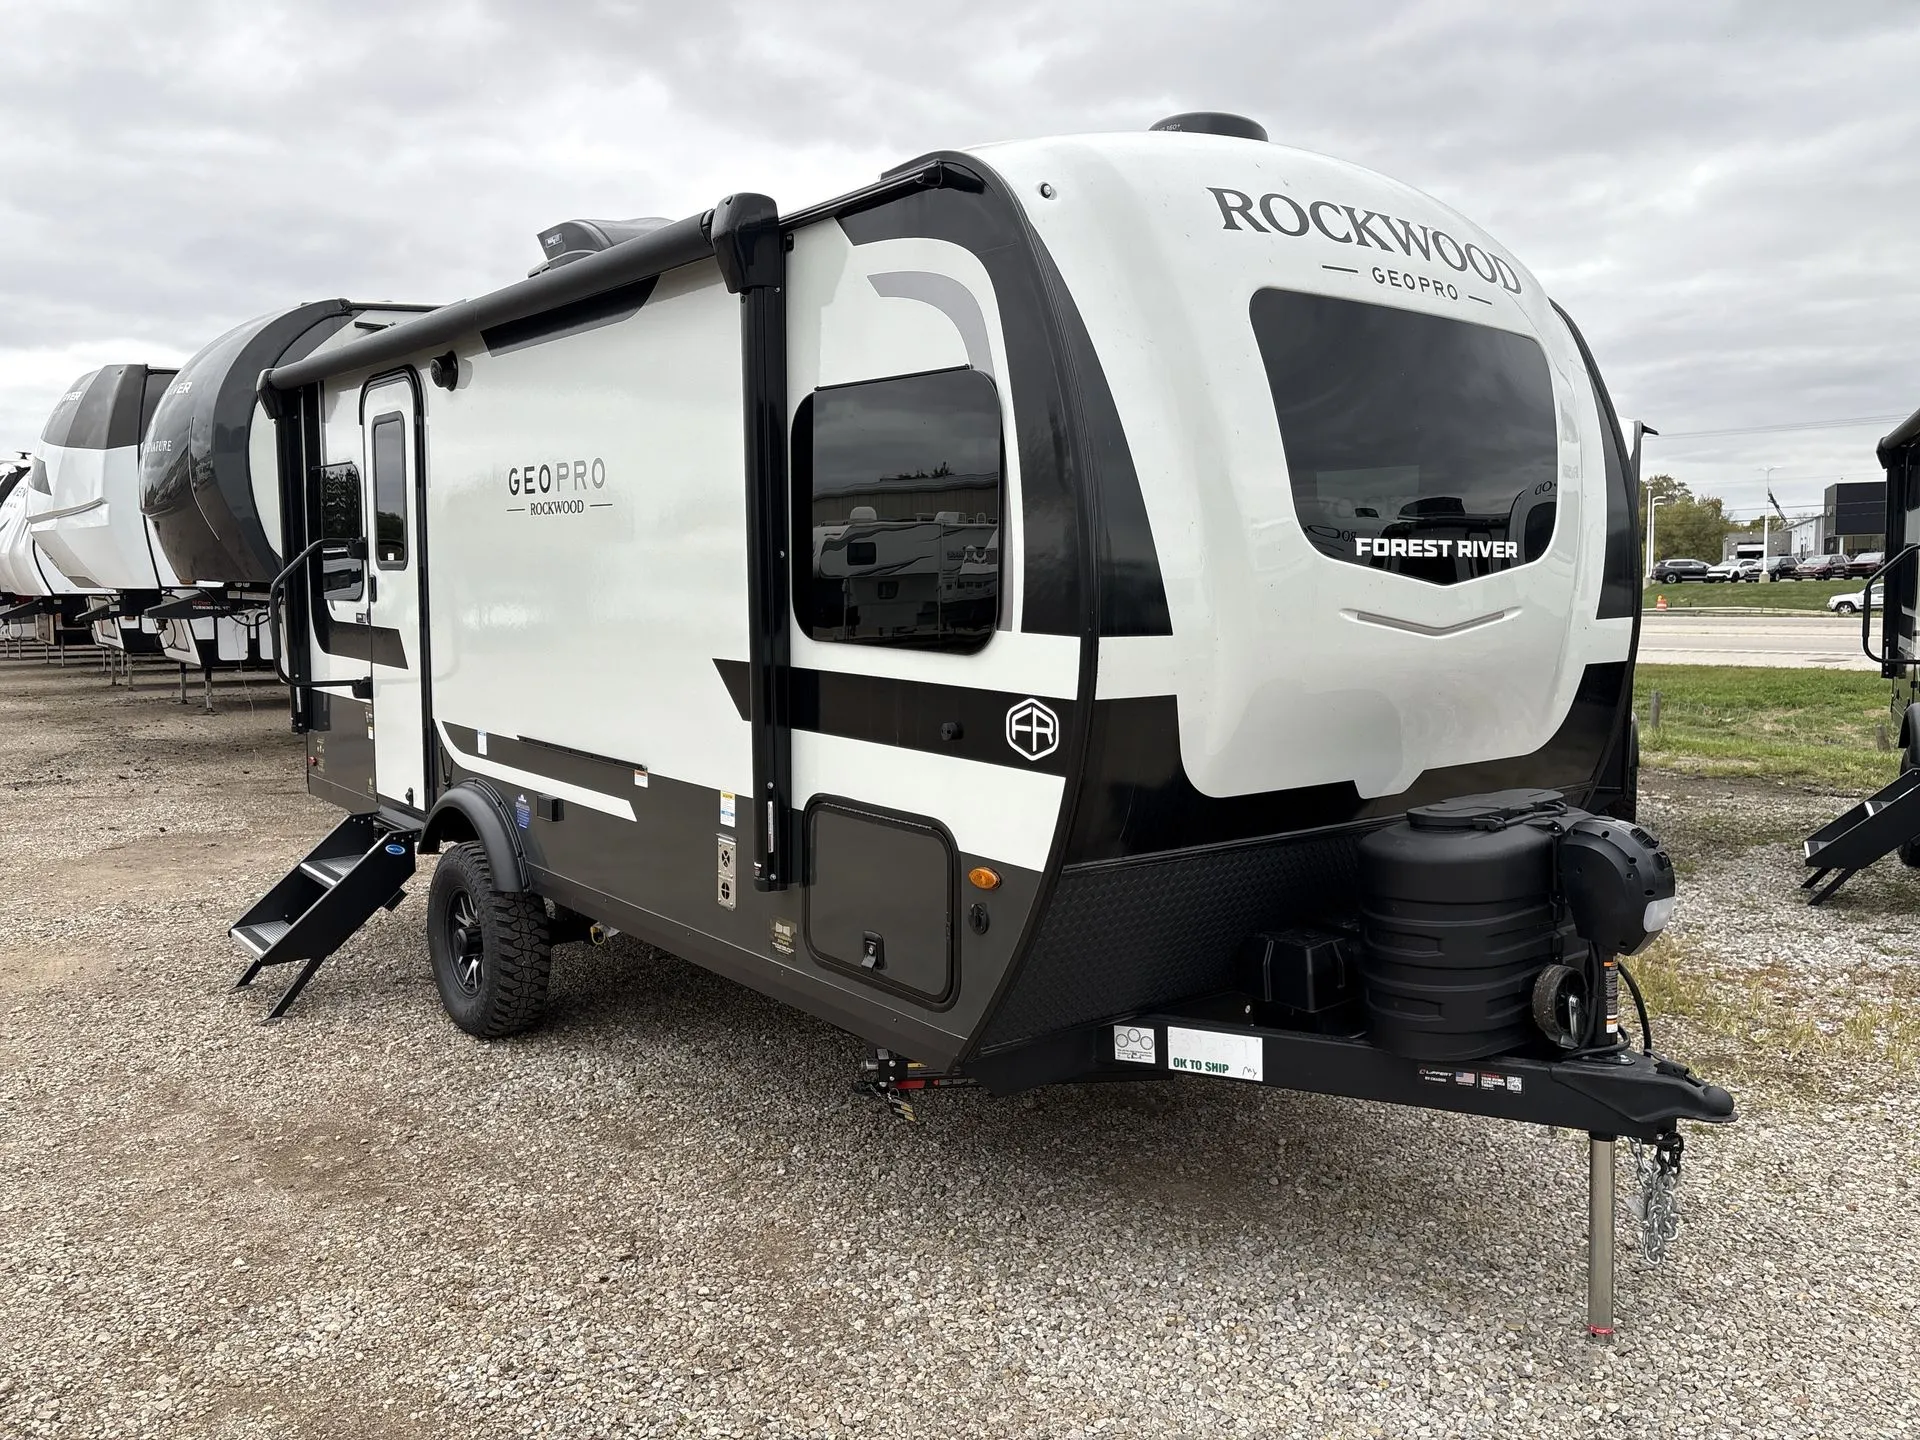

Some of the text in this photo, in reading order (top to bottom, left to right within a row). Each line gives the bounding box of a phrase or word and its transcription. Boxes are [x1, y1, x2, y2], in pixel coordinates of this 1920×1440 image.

[1206, 186, 1522, 295] ROCKWOOD
[1371, 266, 1459, 301] GEOPRO
[508, 457, 606, 496] GEOPRO
[530, 499, 585, 516] ROCKWOOD
[1354, 537, 1518, 559] FOREST RIVER
[1173, 1057, 1229, 1074] OK TO SHIP
